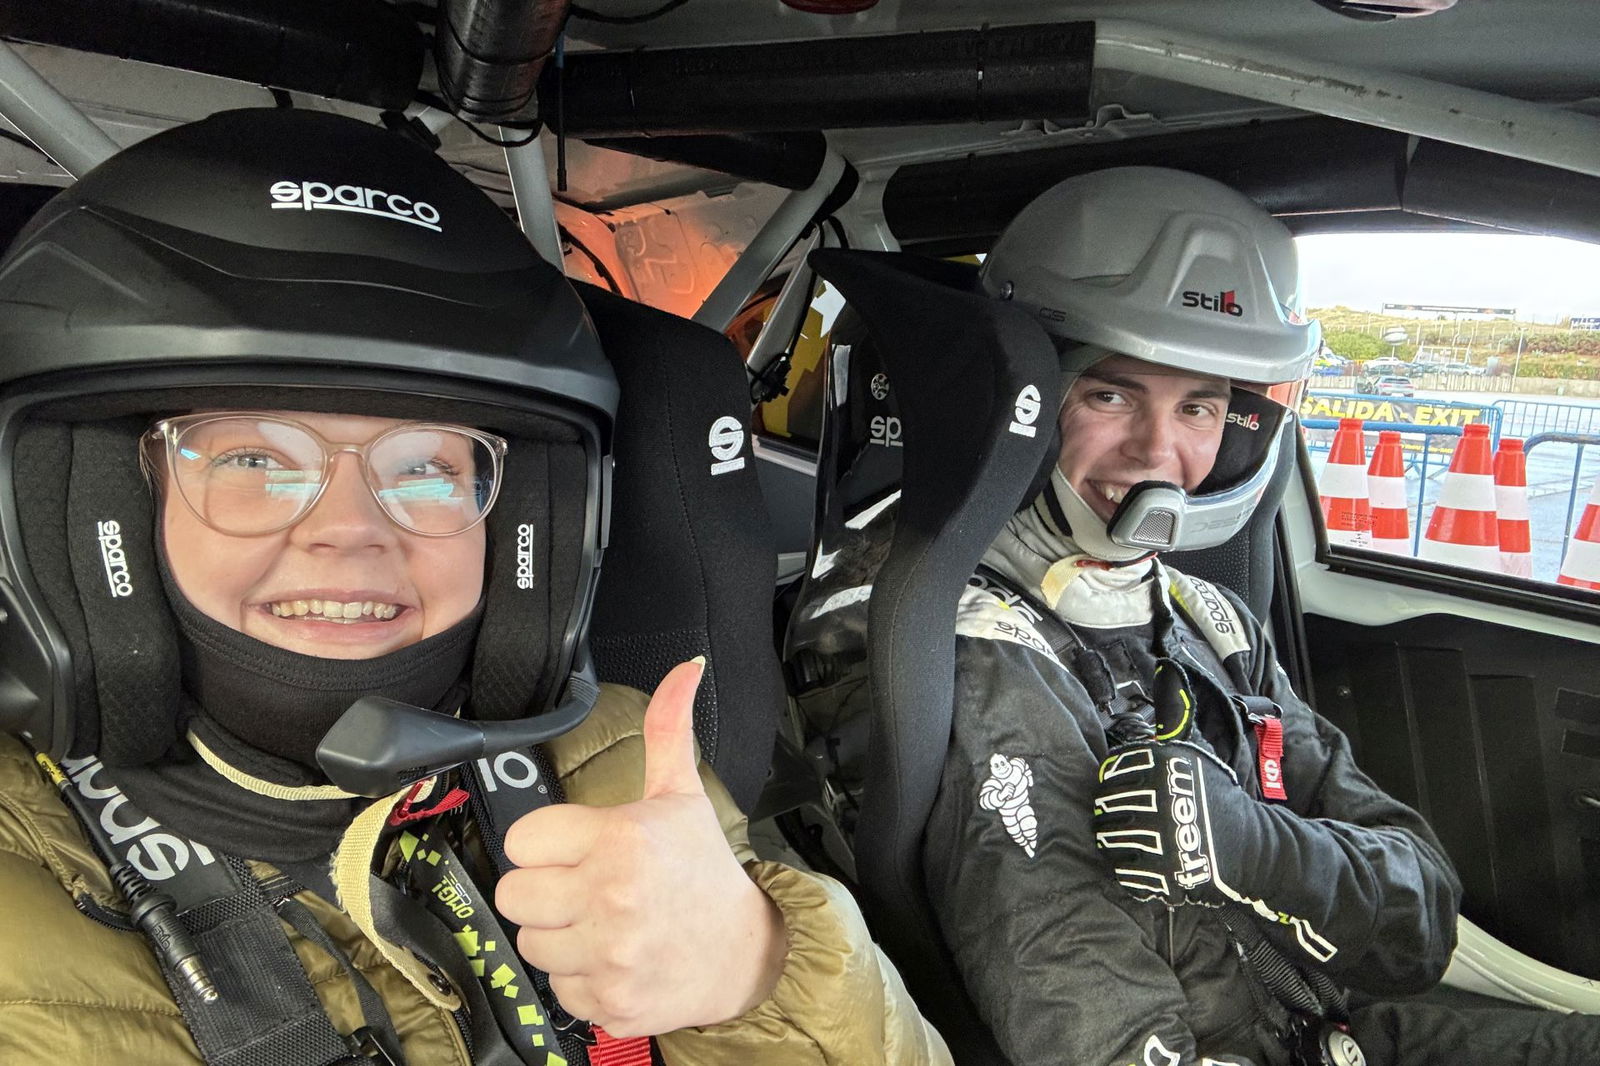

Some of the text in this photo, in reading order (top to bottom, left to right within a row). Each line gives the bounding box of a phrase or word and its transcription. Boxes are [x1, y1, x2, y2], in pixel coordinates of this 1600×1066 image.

[270, 180, 443, 232] sparco
[1301, 396, 1395, 422] SALIDA
[1413, 406, 1481, 427] EXIT
[98, 520, 133, 598] sparco
[517, 524, 534, 590] sparco
